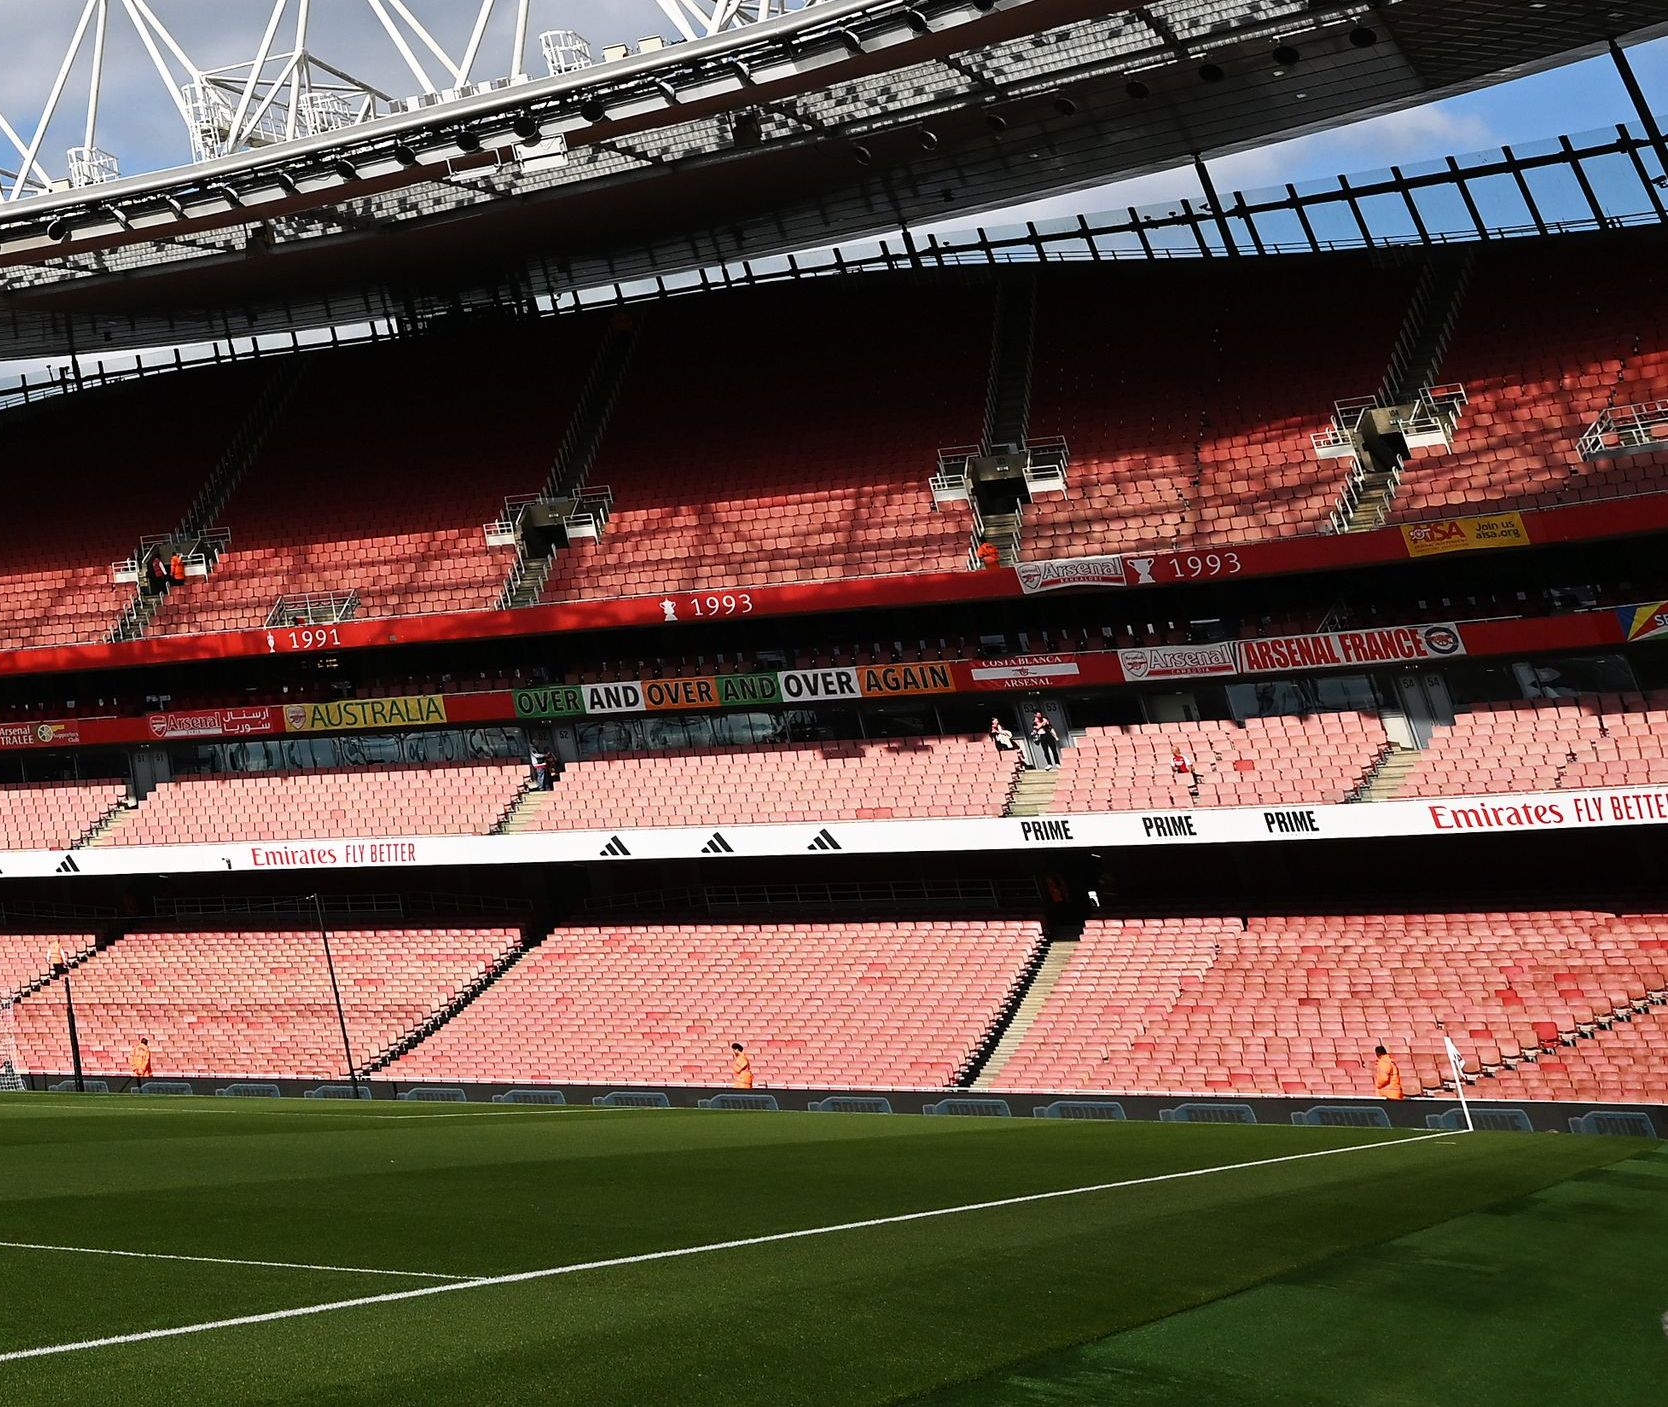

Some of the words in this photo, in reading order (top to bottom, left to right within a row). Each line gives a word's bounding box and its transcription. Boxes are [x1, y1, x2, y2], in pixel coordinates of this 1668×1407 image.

[1476, 523, 1495, 532] Join
[1501, 520, 1515, 528] us
[1476, 529, 1521, 540] aisa.org
[1043, 555, 1123, 581] Arsenal
[1169, 552, 1241, 578] 1993
[690, 594, 754, 617] 1993
[288, 629, 341, 649] 1991
[1243, 635, 1341, 670] ARSENAL
[1338, 628, 1428, 662] FRANCE
[982, 659, 1016, 667] COSTA
[1016, 656, 1062, 665] BLANCA
[1149, 644, 1232, 669] Arsenal
[517, 686, 580, 714] OVER
[590, 685, 640, 710] AND
[647, 680, 714, 706] OVER
[723, 676, 778, 702] AND
[784, 671, 856, 698] OVER
[866, 665, 950, 693] AGAIN
[1004, 677, 1053, 688] ARSENAL
[167, 711, 221, 730] Arsenal
[311, 697, 444, 728] AUSTRALIA
[0, 725, 31, 736] Arsenal
[0, 735, 34, 745] TRALEE
[1264, 810, 1320, 833] PRIME
[1428, 803, 1564, 829] Emirates
[1573, 797, 1603, 822] FLY
[1610, 793, 1668, 820] BETTE
[1021, 820, 1074, 841] PRIME
[1142, 815, 1197, 838] PRIME
[251, 846, 337, 866] Emirates
[345, 844, 365, 863] FLY
[370, 843, 416, 863] BETTER
